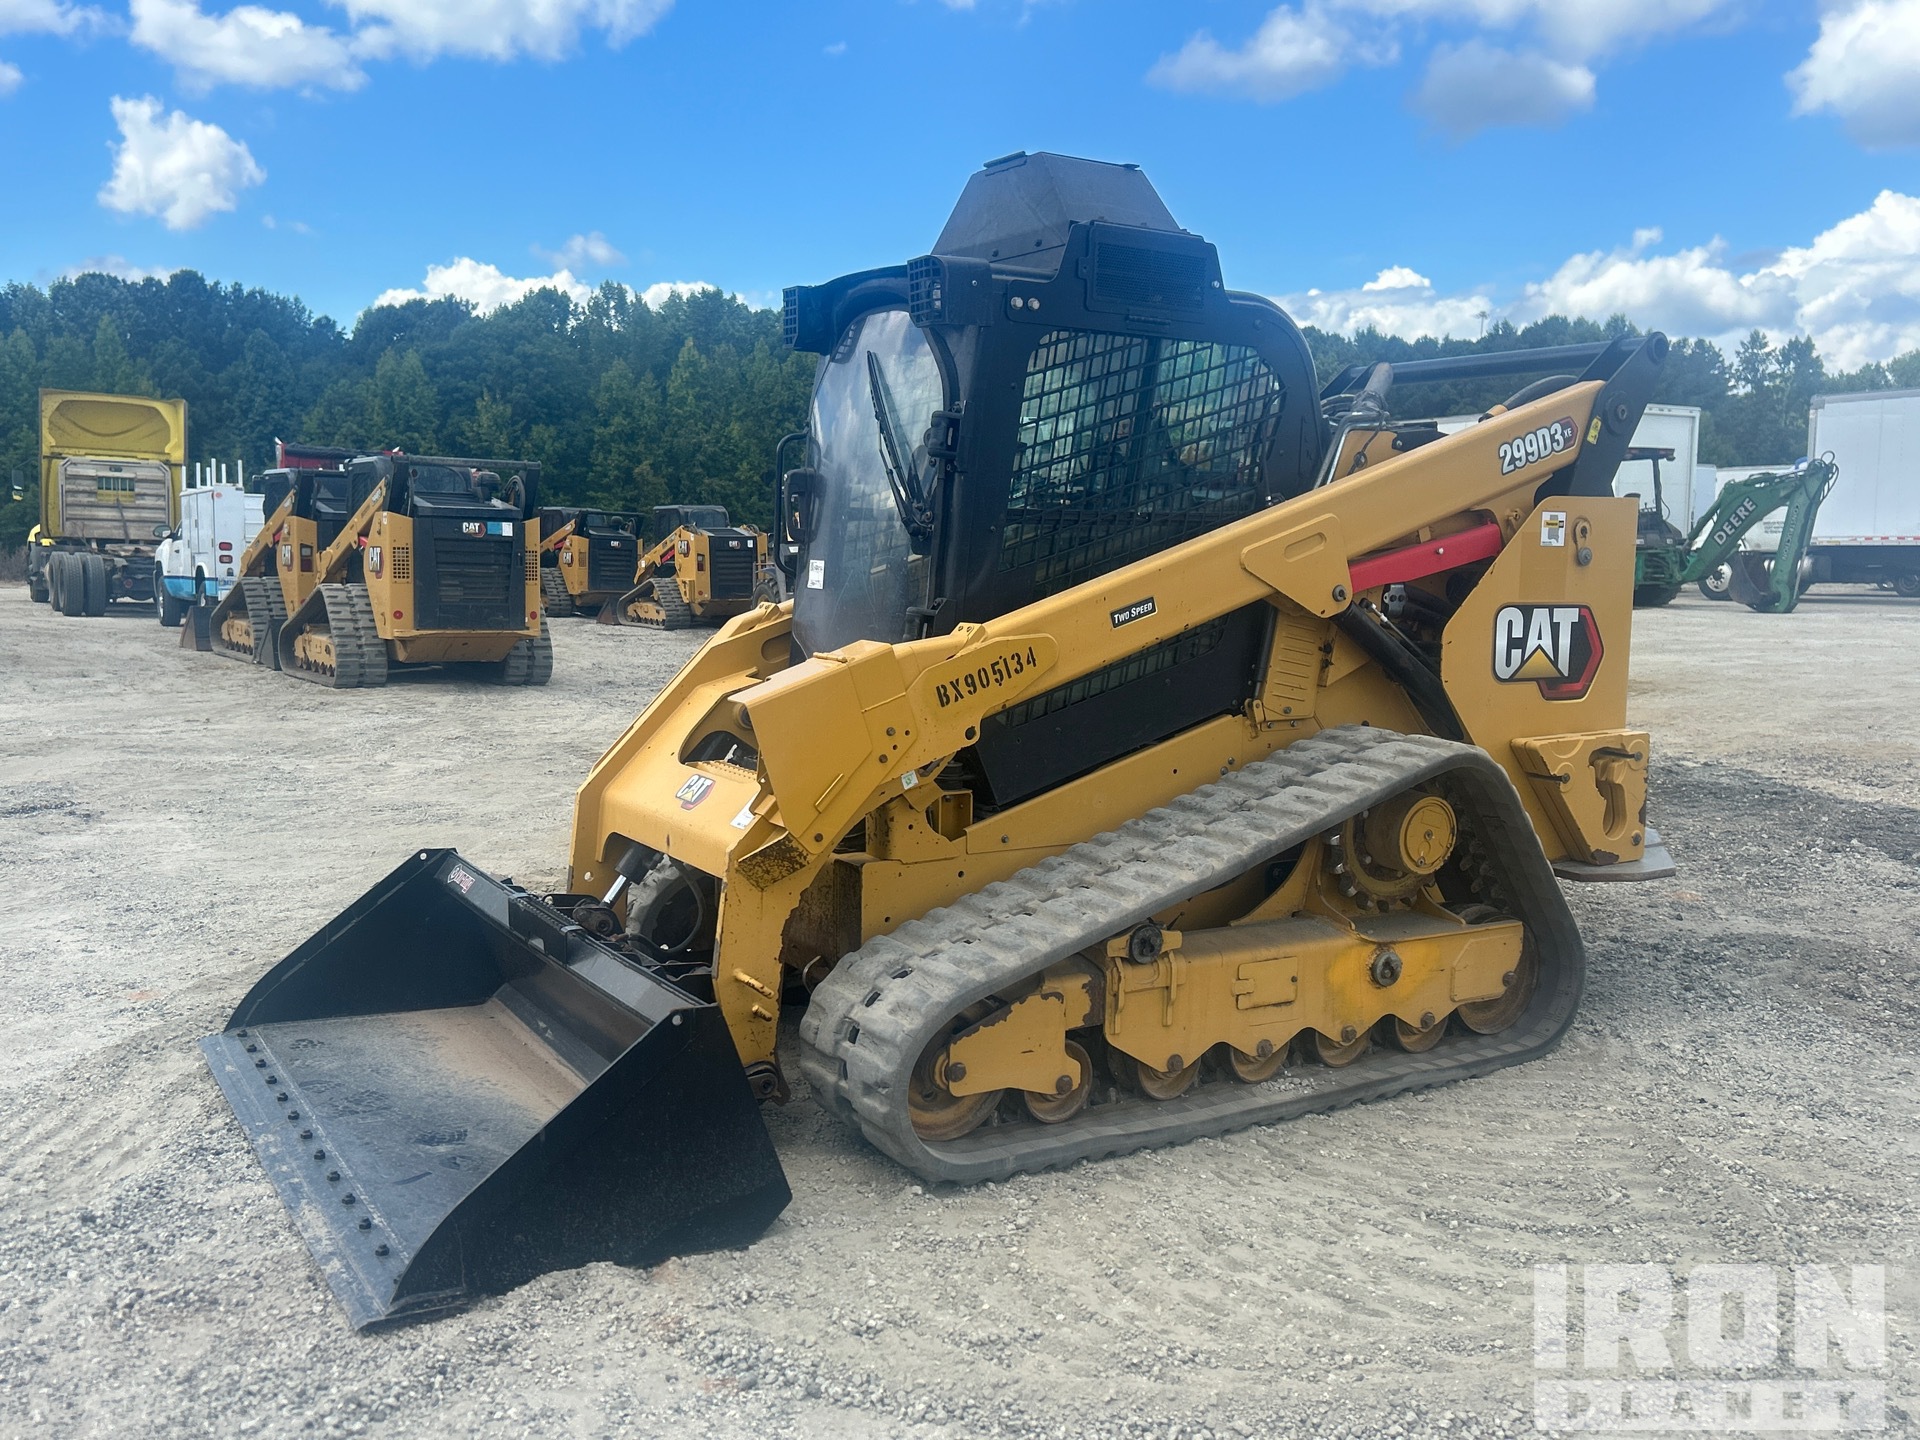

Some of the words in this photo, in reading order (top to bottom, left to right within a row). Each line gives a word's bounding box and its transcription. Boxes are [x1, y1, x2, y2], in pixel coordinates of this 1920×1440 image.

[1499, 422, 1565, 475] 299D3
[462, 521, 480, 533] CAT
[1713, 497, 1757, 545] DEERE
[282, 544, 292, 566] CAT
[369, 546, 381, 572] CAT
[563, 552, 572, 564] CAT
[678, 539, 688, 554] CAT
[1495, 607, 1579, 680] CAT
[935, 646, 1037, 708] BX905134
[676, 774, 714, 803] CAT
